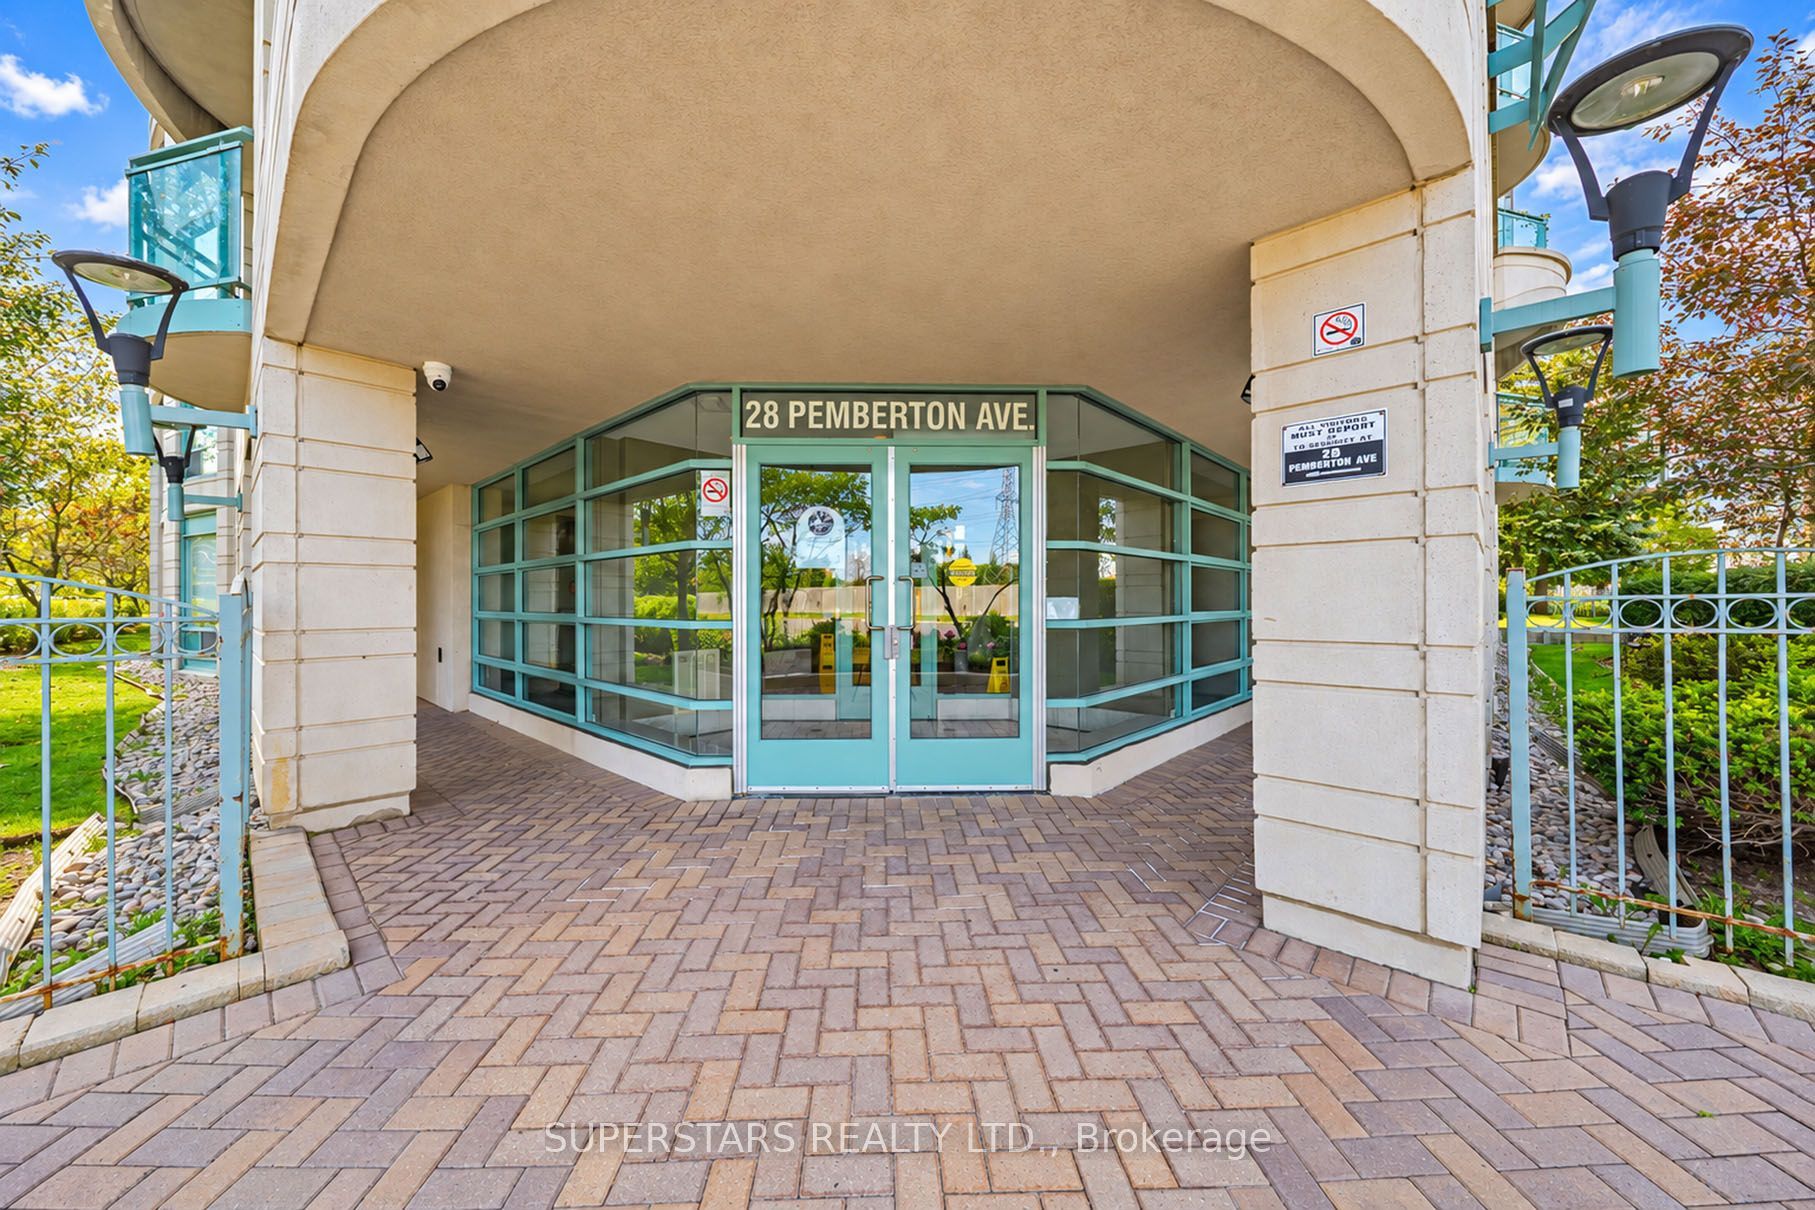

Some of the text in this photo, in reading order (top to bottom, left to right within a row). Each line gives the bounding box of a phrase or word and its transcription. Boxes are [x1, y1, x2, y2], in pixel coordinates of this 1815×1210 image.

[746, 400, 1035, 431] 28 PEMBERTON AVE.
[1291, 428, 1323, 440] MUST
[1288, 453, 1378, 473] PEMBERTON AVE
